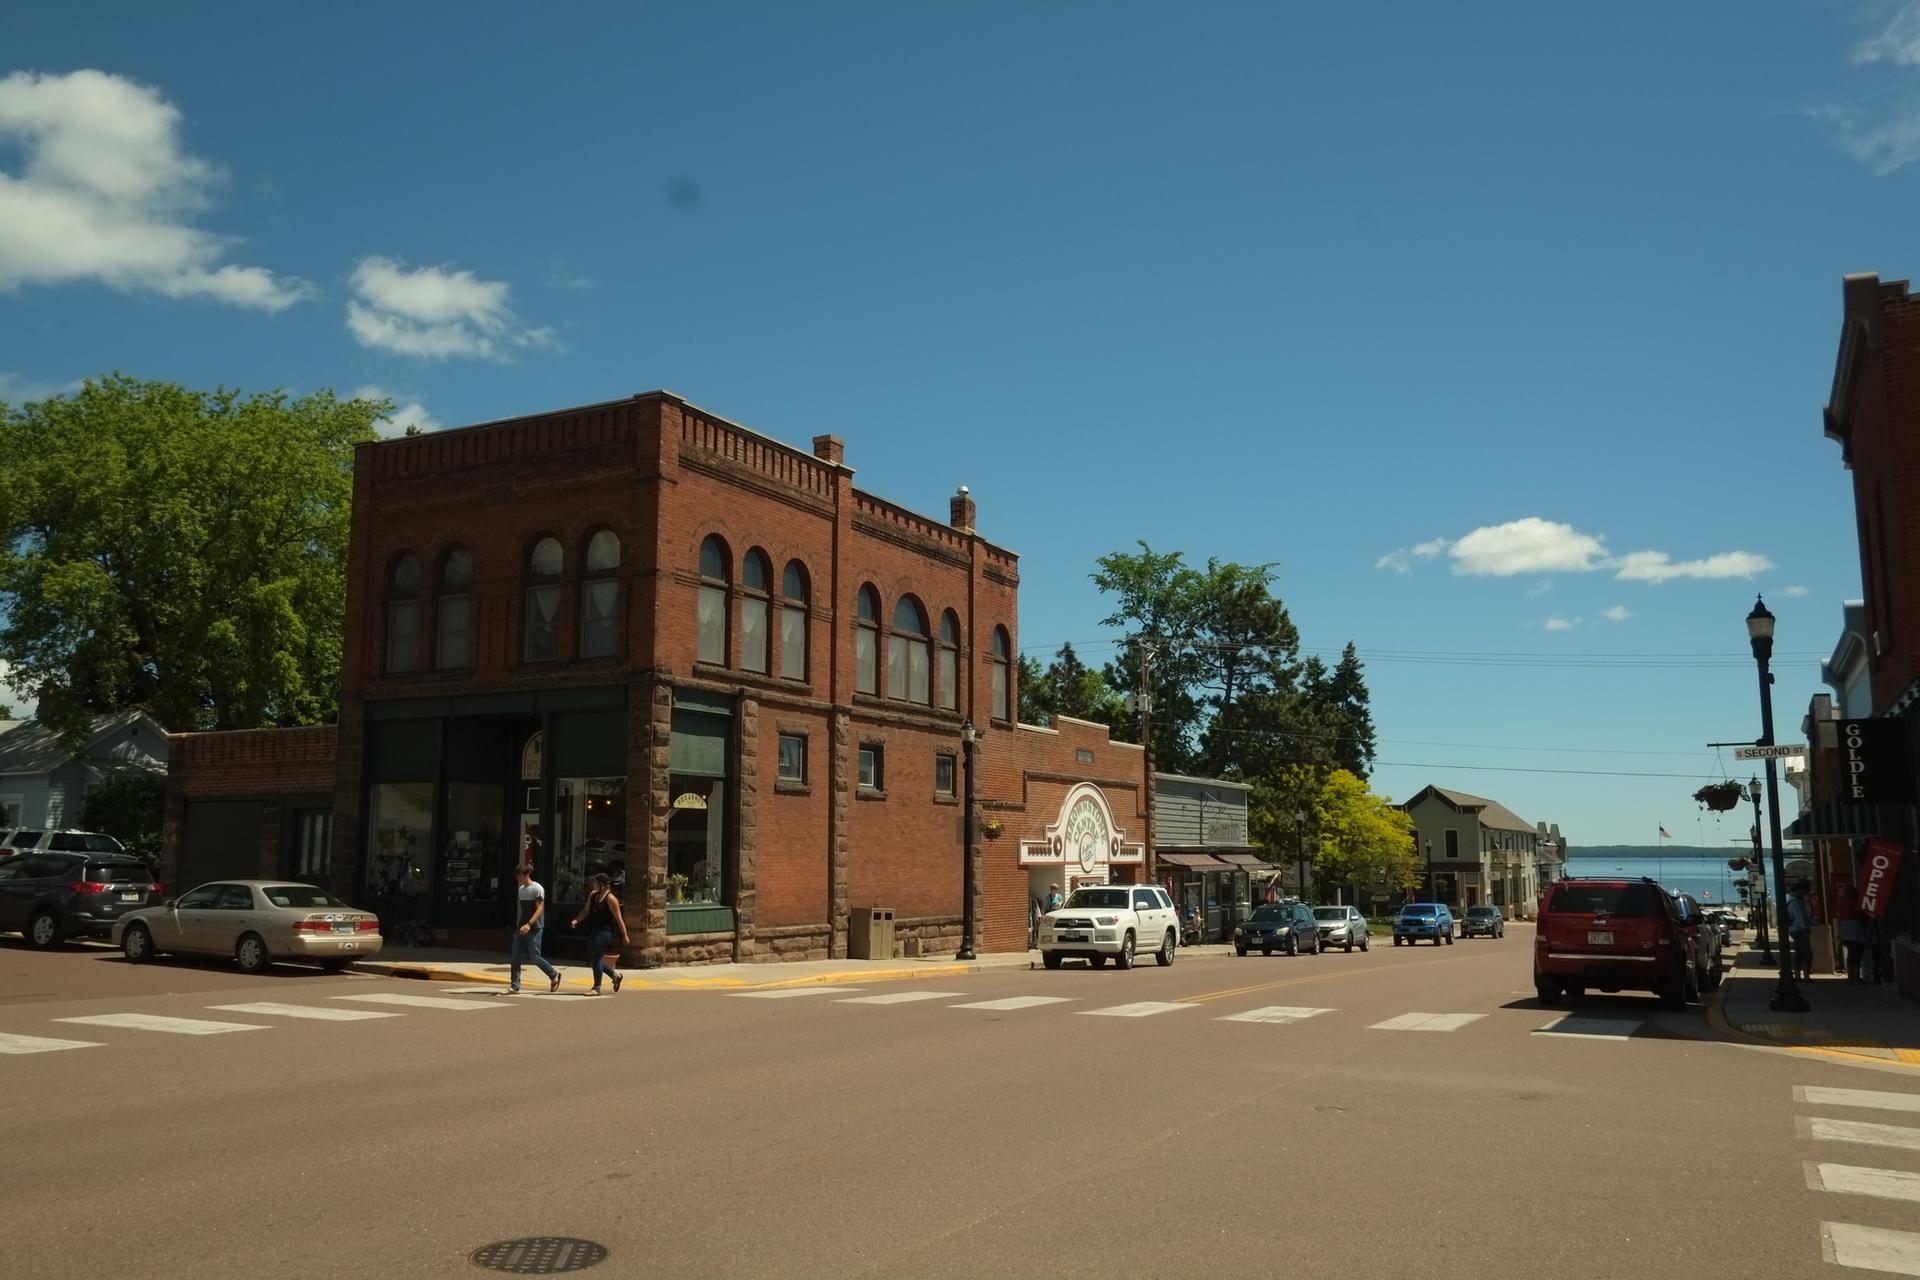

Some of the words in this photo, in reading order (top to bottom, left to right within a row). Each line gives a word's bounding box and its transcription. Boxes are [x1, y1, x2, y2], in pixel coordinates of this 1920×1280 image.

[1736, 750, 1743, 758] S
[1744, 746, 1790, 758] SECOND
[1845, 723, 1865, 798] GOLDIE
[1861, 855, 1890, 912] OPEN
